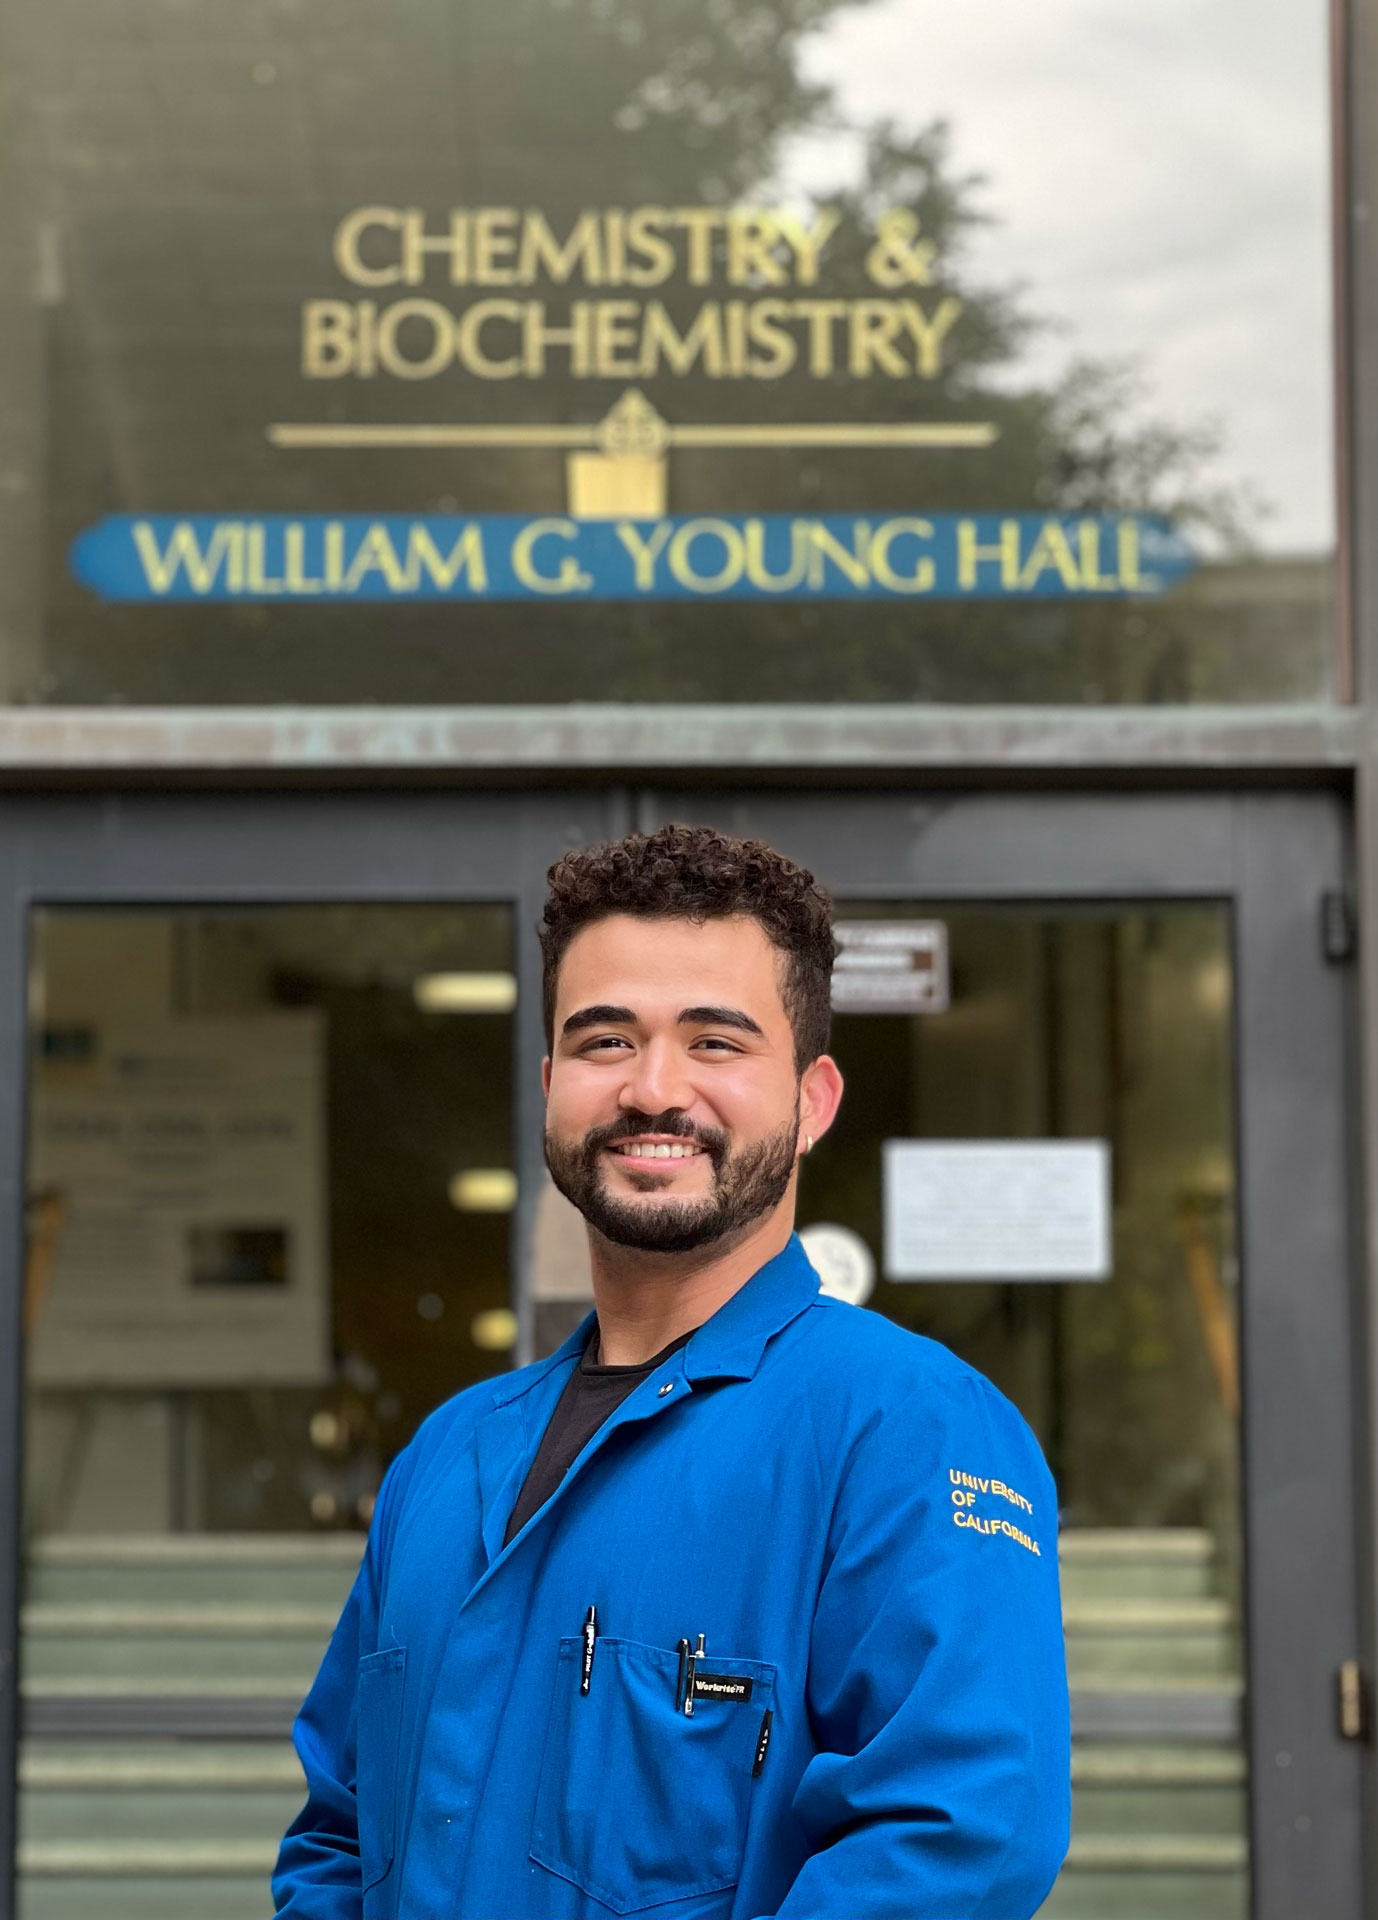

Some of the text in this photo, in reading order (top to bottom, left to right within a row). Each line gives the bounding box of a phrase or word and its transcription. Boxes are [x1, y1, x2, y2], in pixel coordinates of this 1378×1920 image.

[333, 206, 938, 288] CHEMISTRY &
[301, 298, 960, 381] BIOCHEMISTRY
[132, 516, 1162, 597] WILLIAM G. YOUNG HALL
[949, 1468, 1033, 1515] UNIVERSITY
[951, 1489, 976, 1507] OF
[953, 1511, 1041, 1557] CALIFORNIA
